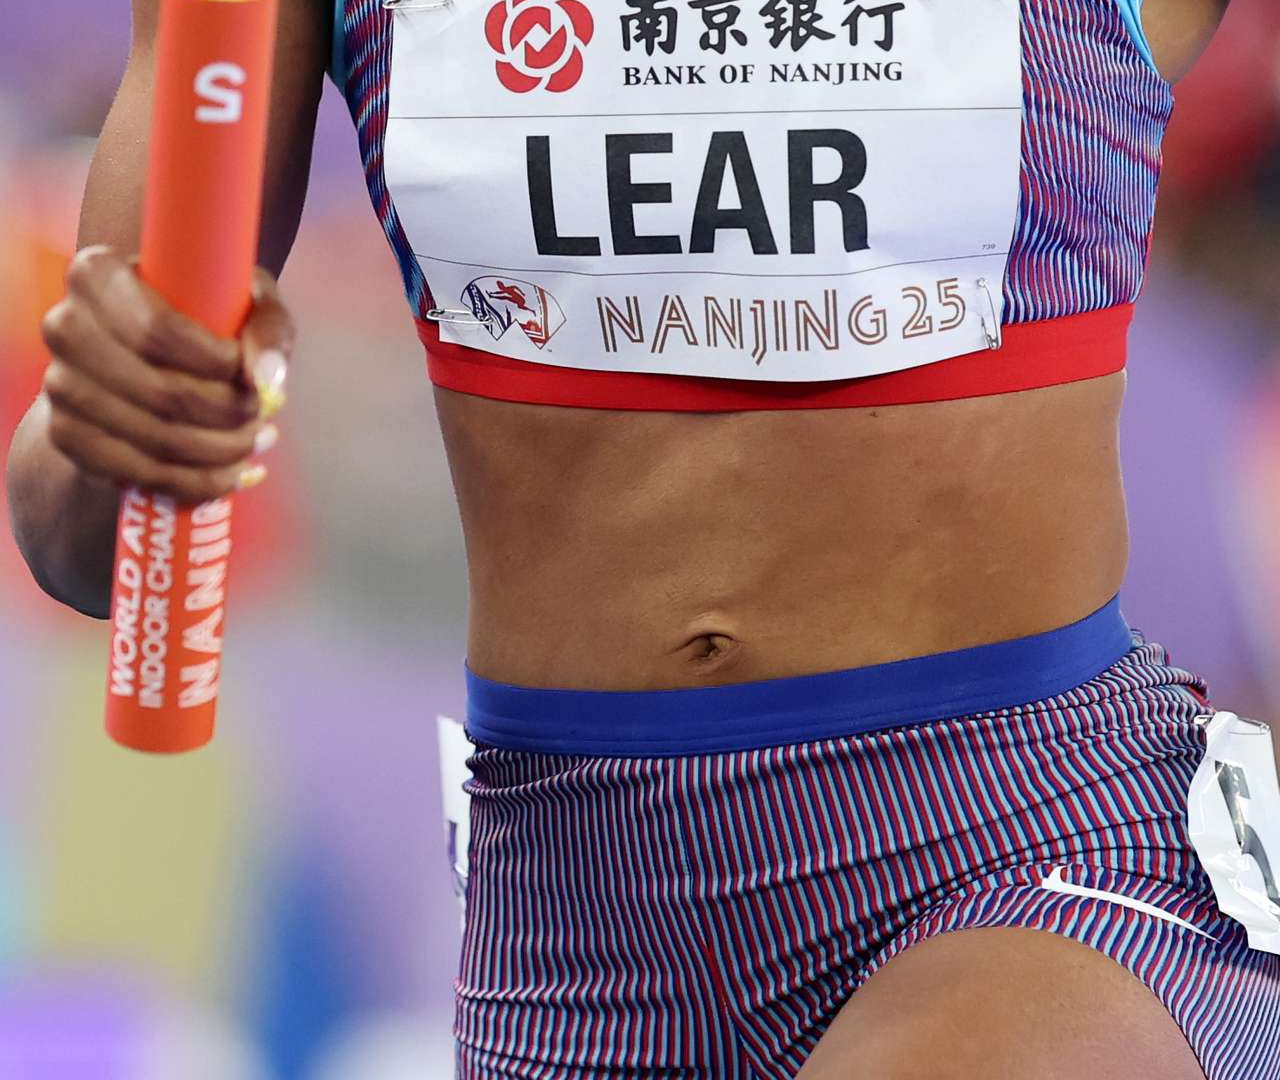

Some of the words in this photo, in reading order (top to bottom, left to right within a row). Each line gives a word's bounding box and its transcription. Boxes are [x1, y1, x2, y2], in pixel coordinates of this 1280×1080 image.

[623, 64, 707, 87] BANK
[719, 63, 755, 85] OF
[769, 61, 903, 86] NANJING
[525, 128, 871, 257] LEAR
[596, 288, 888, 367] NANJING
[901, 277, 967, 338] 25
[111, 557, 143, 697] WORLD
[138, 596, 170, 709] INDOOR
